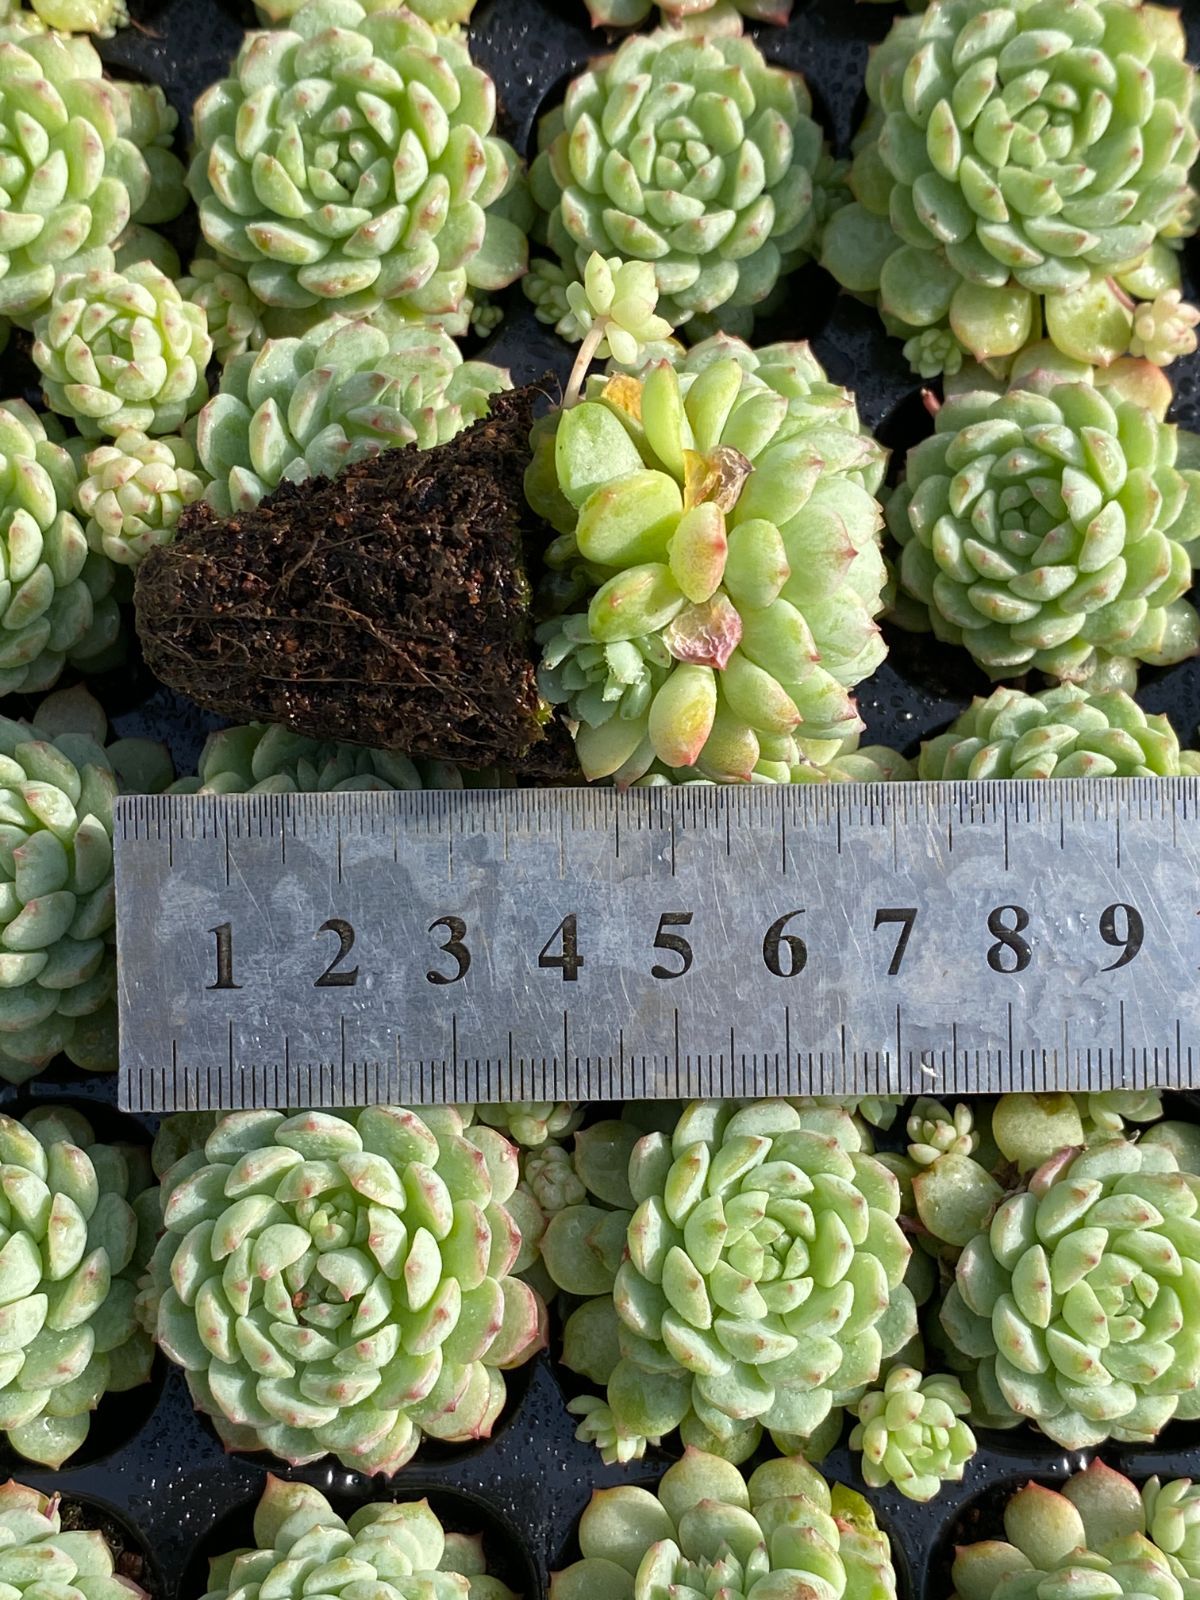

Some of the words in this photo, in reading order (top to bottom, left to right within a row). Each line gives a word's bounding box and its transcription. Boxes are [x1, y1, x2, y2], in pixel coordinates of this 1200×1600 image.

[205, 922, 244, 990] 1
[312, 918, 360, 988] 2
[425, 915, 472, 985] 3
[537, 913, 585, 982] 4
[651, 911, 694, 980] 5
[762, 908, 808, 978] 6
[872, 907, 918, 976] 7
[987, 904, 1032, 974] 8
[1099, 902, 1145, 972] 9
